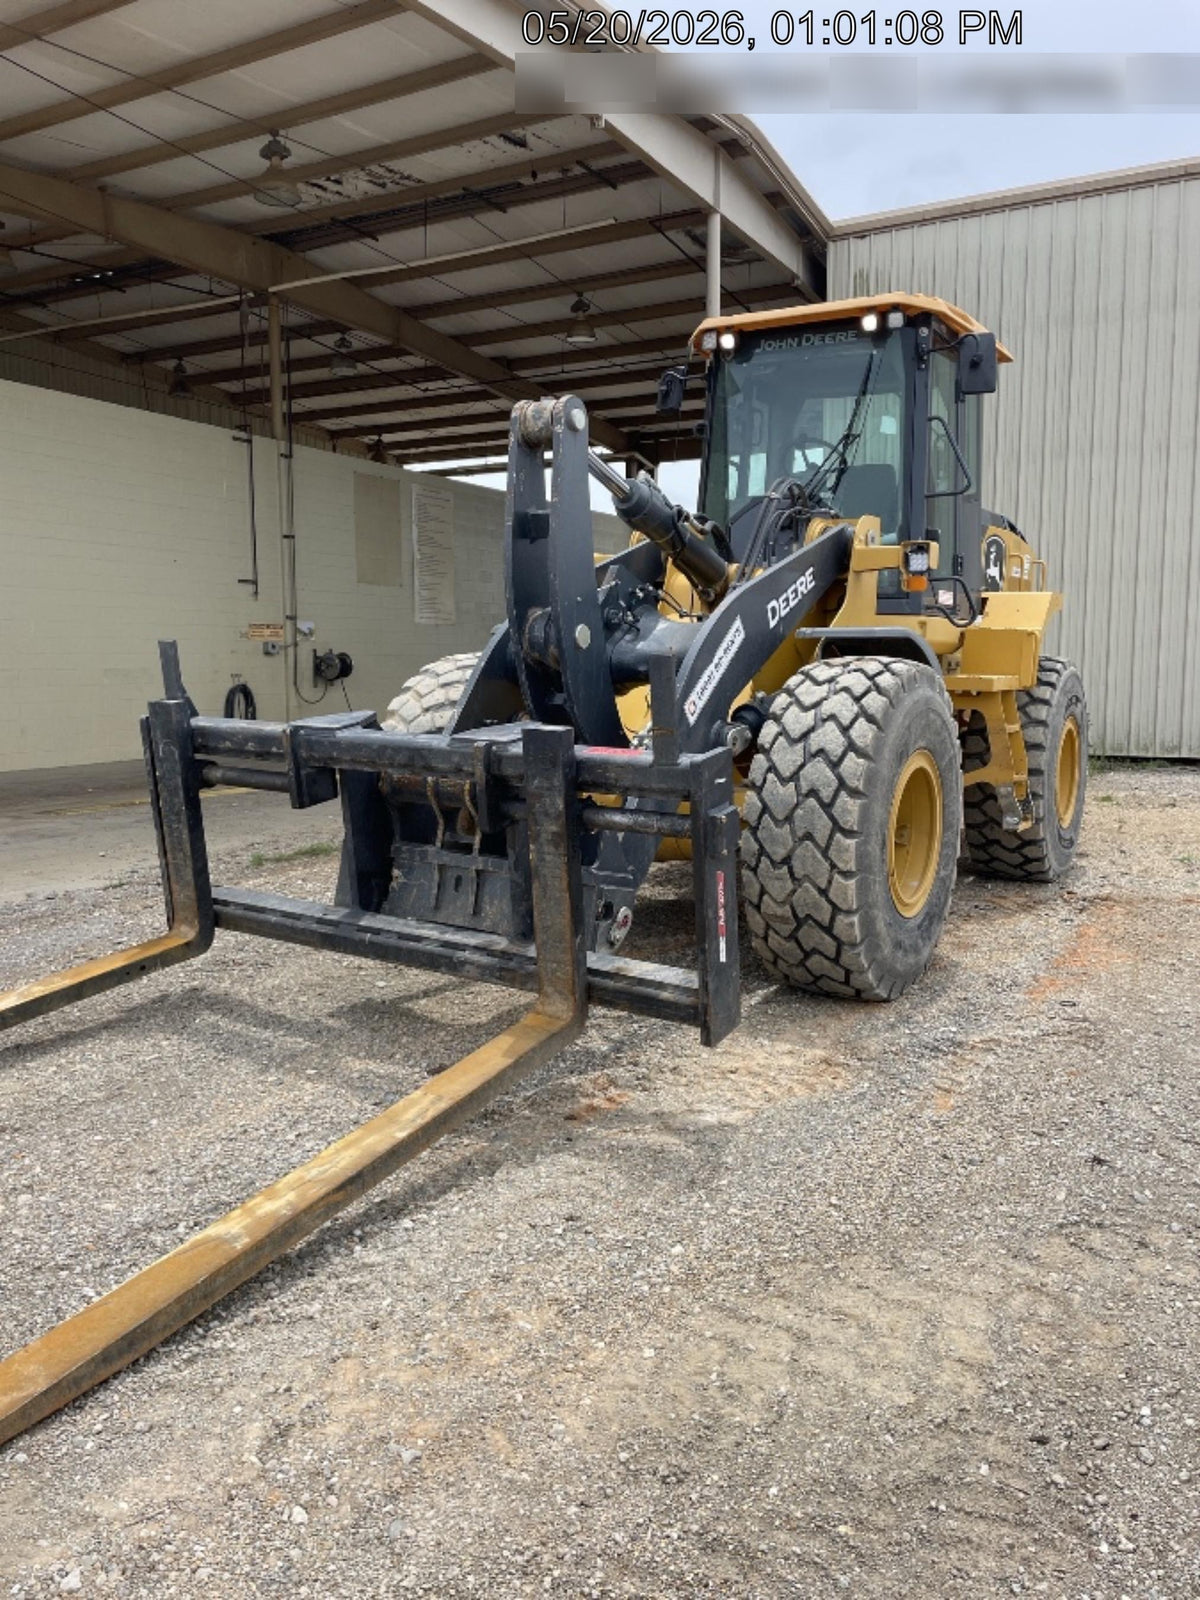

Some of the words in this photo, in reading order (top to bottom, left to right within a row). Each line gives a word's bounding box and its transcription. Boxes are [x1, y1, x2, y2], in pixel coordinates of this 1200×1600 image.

[759, 337, 799, 352] JOHN
[801, 330, 858, 347] DEERE
[766, 566, 816, 630] DEERE
